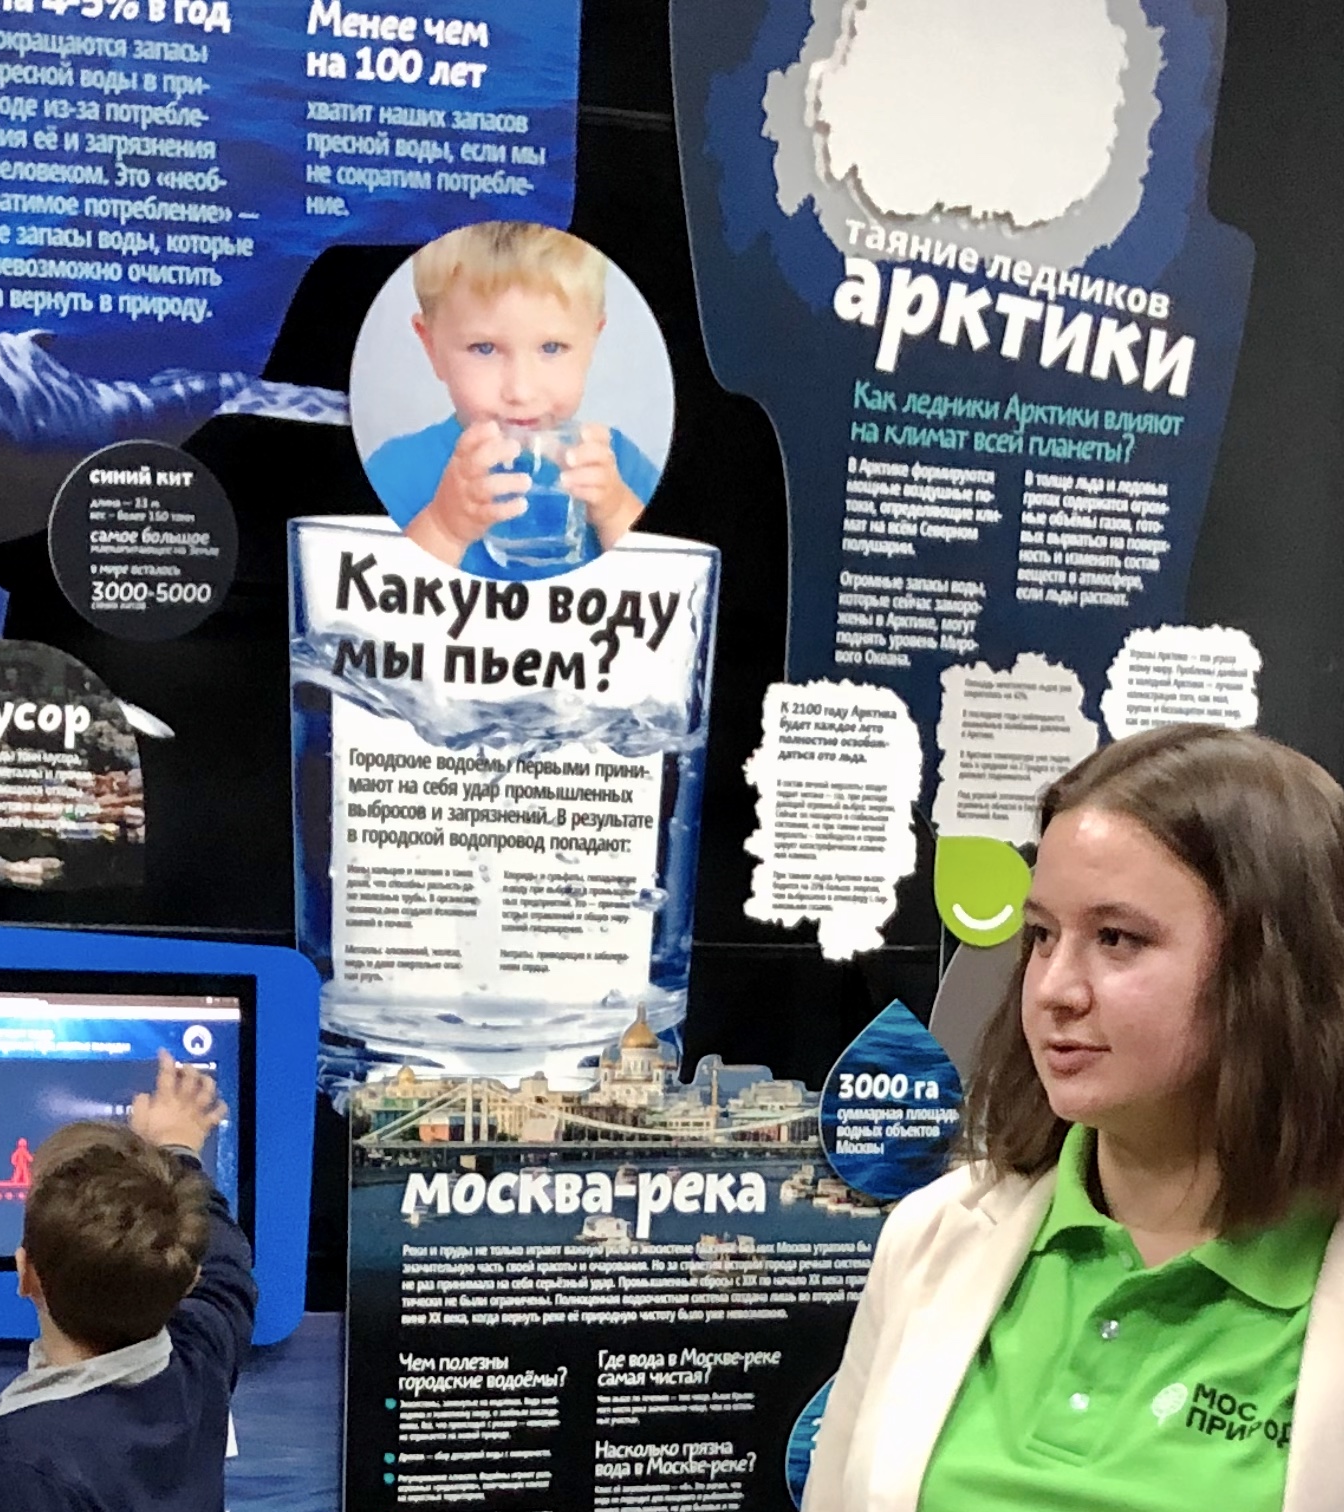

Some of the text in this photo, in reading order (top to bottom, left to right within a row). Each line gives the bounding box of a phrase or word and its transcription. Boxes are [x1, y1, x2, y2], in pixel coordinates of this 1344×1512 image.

[307, 0, 489, 48] Менее чем
[307, 46, 488, 88] на 100 лет
[128, 263, 223, 287] очистить
[844, 218, 1172, 321] таяние ледников
[833, 256, 1198, 398] арктики
[855, 378, 1185, 436] Как ледники Арктики влияют
[851, 420, 1135, 465] на климат всей планеты?
[89, 465, 195, 488] синий кит
[90, 525, 211, 545] самое большое
[91, 581, 212, 604] 3000-5000
[335, 550, 681, 653] Какую воду
[332, 625, 620, 692] мы пьем?
[362, 827, 444, 850] городской
[449, 832, 545, 853] водопровод
[550, 835, 632, 856] попадают:
[838, 1073, 939, 1100] 3000 га
[836, 1140, 885, 1155] Москвы
[401, 1170, 766, 1240] москва-река
[399, 1352, 509, 1373] Чем полезны
[597, 1347, 782, 1373] Где вода в Москве-реке
[398, 1367, 568, 1398] городские водоёмы?
[597, 1365, 713, 1388] самая чистая?
[1193, 1382, 1258, 1422] МОС
[1185, 1406, 1292, 1449] ПРИРОД
[594, 1461, 631, 1480] вода
[646, 1451, 757, 1480] Москве-реке?
[595, 1440, 733, 1464] Насколько грязна
